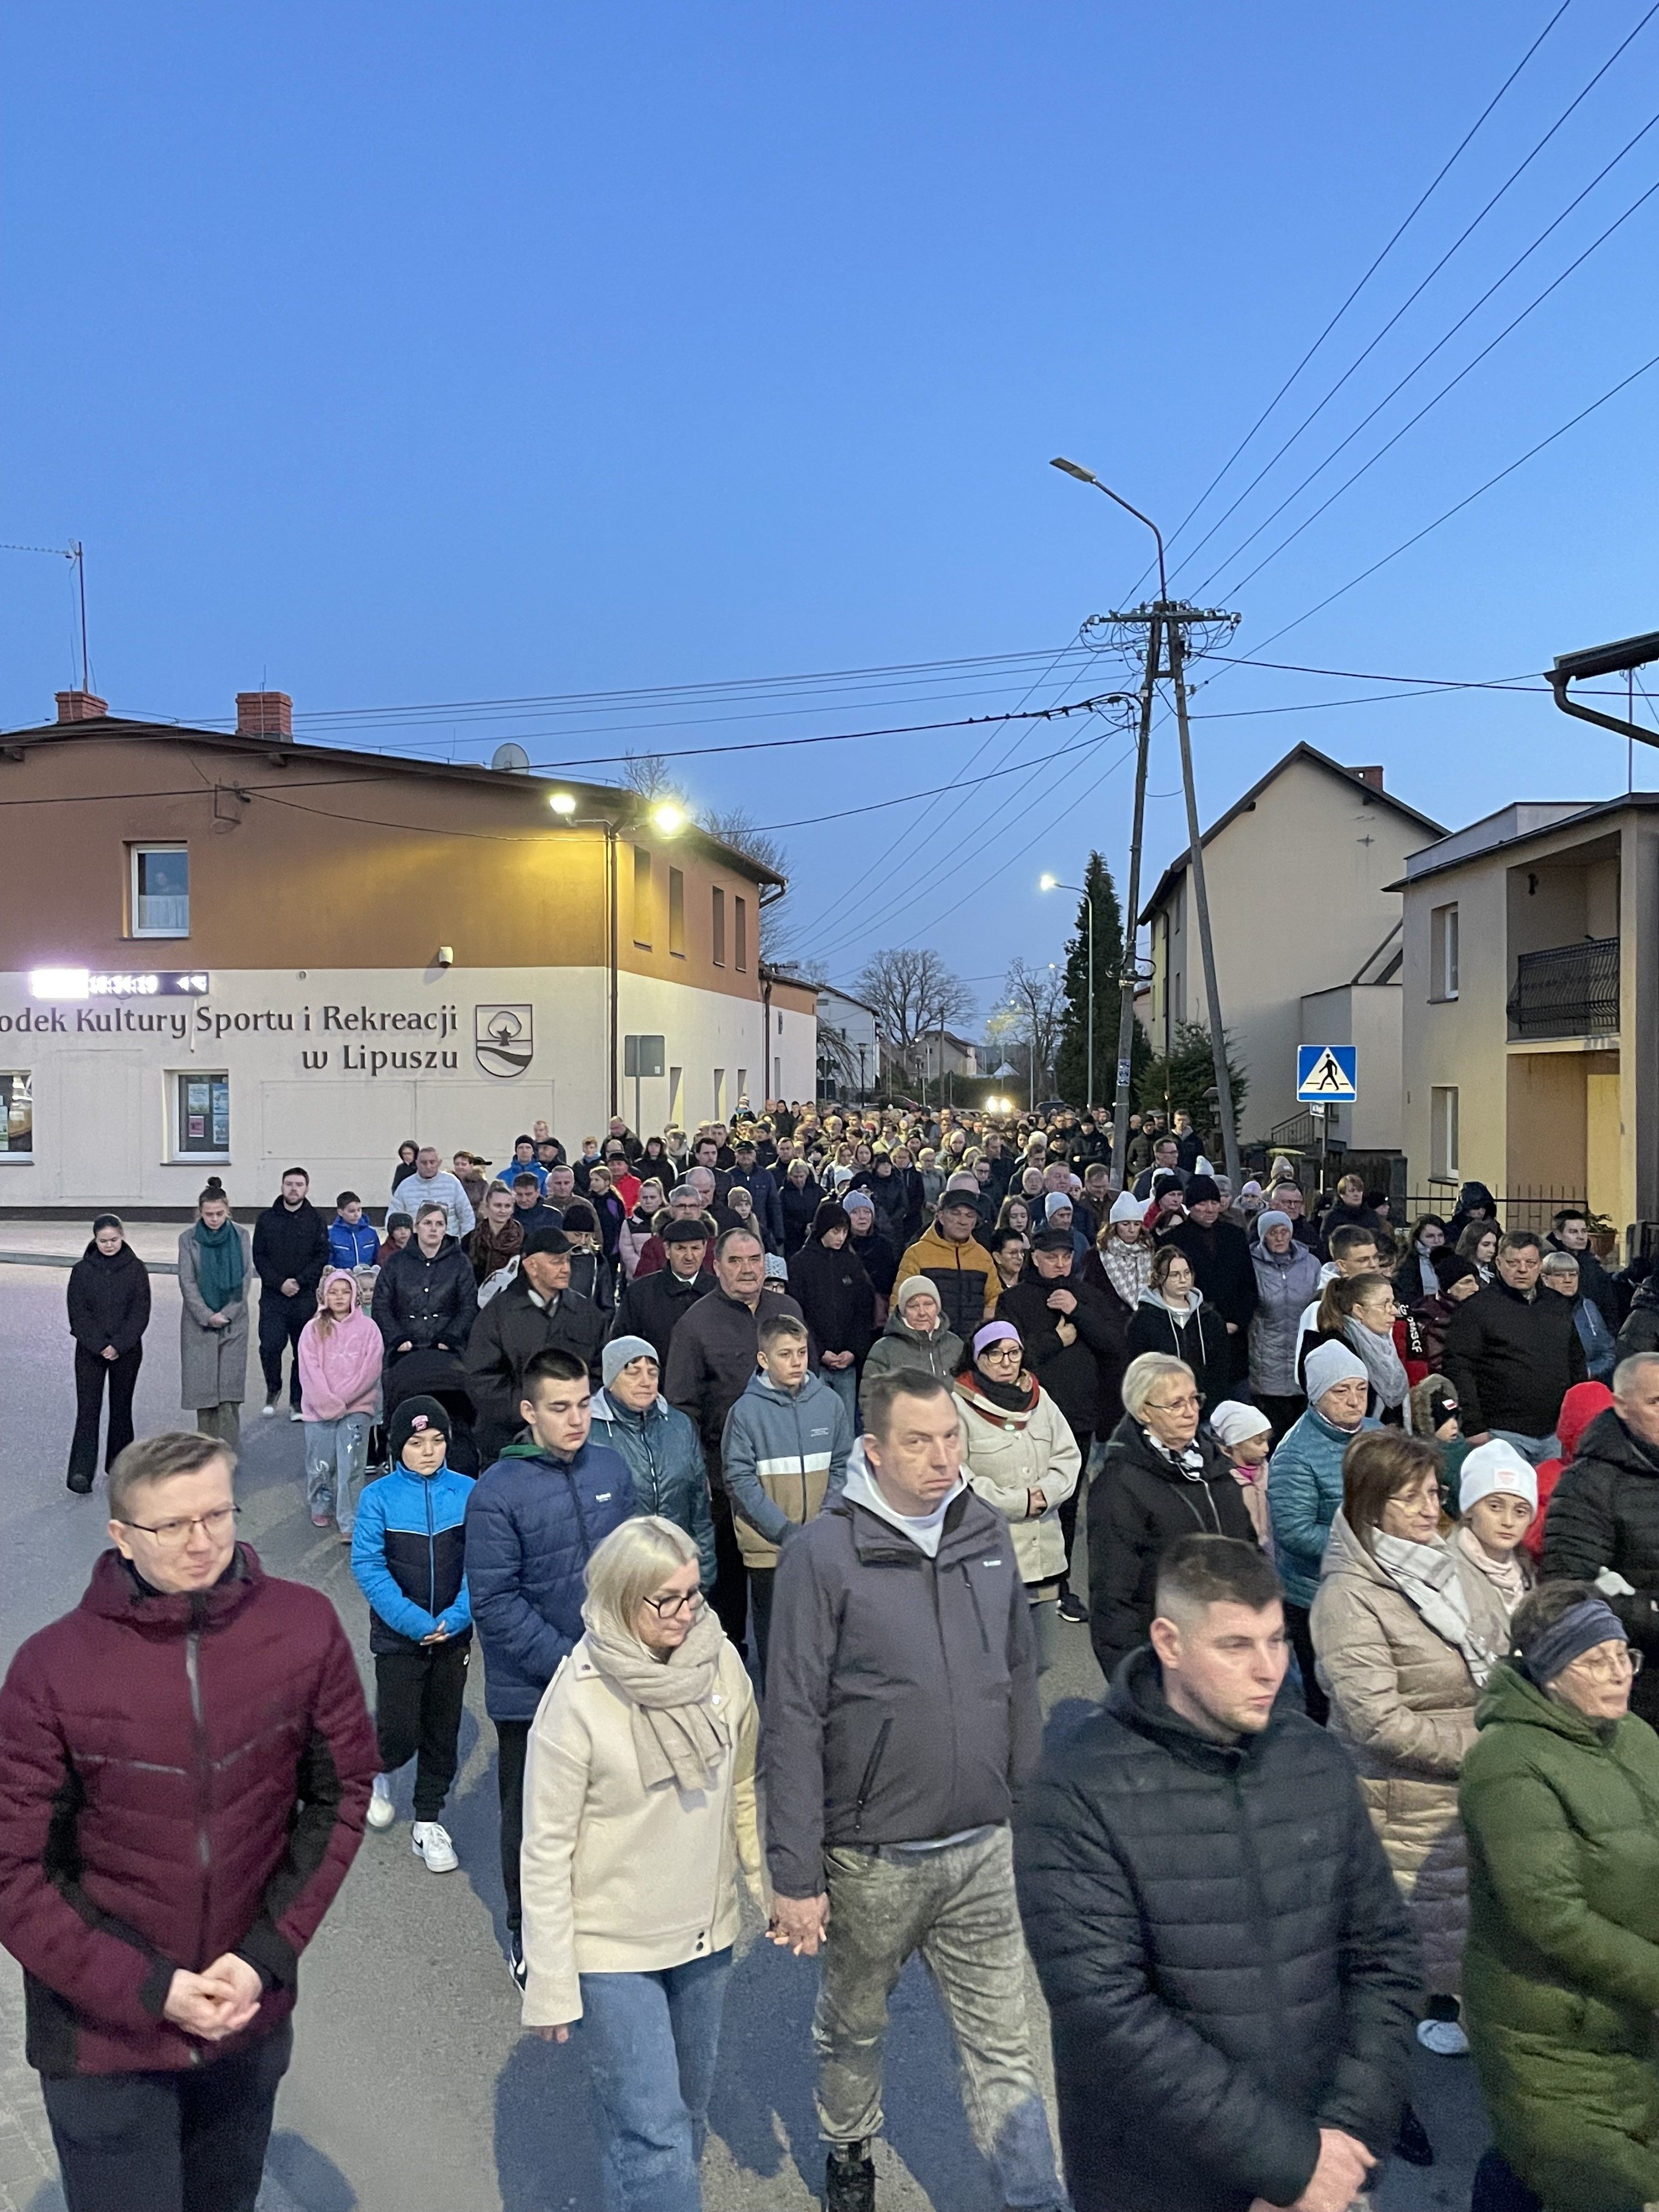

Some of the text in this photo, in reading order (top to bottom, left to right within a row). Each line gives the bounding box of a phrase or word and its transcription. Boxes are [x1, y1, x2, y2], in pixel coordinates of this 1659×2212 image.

[77, 1008, 186, 1039] Kultury
[196, 1006, 294, 1039] Sportu
[303, 1006, 311, 1031] i
[323, 1005, 458, 1039] Rekreacji
[301, 1045, 458, 1077] w Lipuszu
